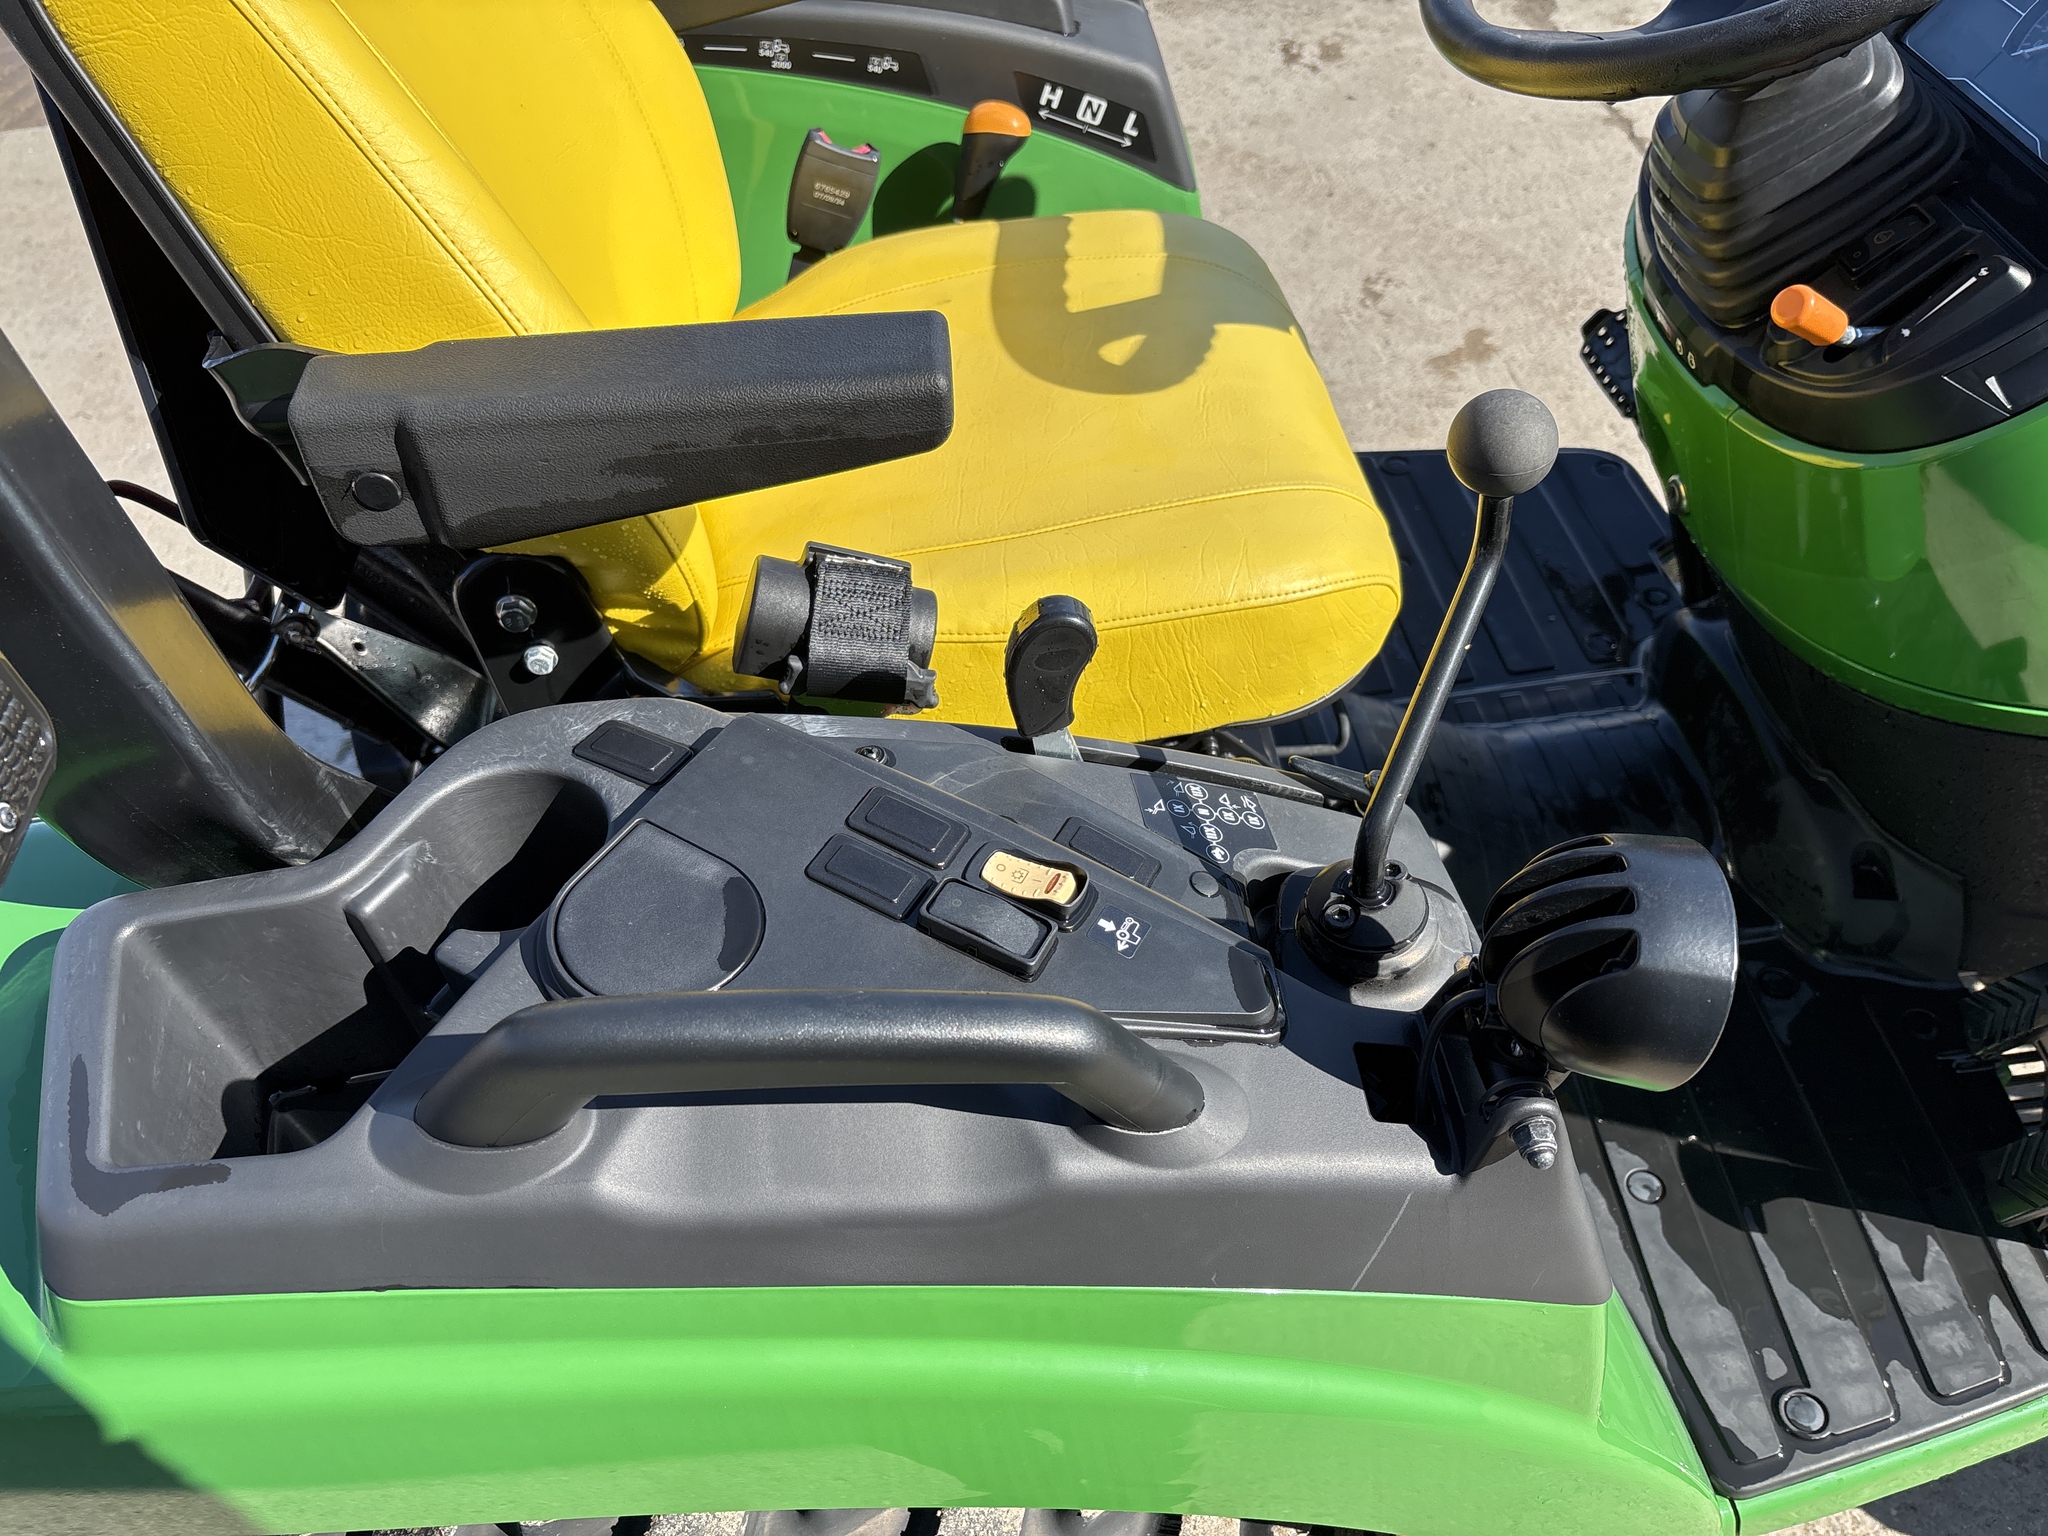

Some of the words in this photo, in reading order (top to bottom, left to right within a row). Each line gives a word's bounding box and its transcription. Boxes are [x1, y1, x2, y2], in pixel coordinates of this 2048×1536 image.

[1039, 82, 1063, 110] H
[1082, 99, 1103, 122] N
[1122, 110, 1139, 137] L
